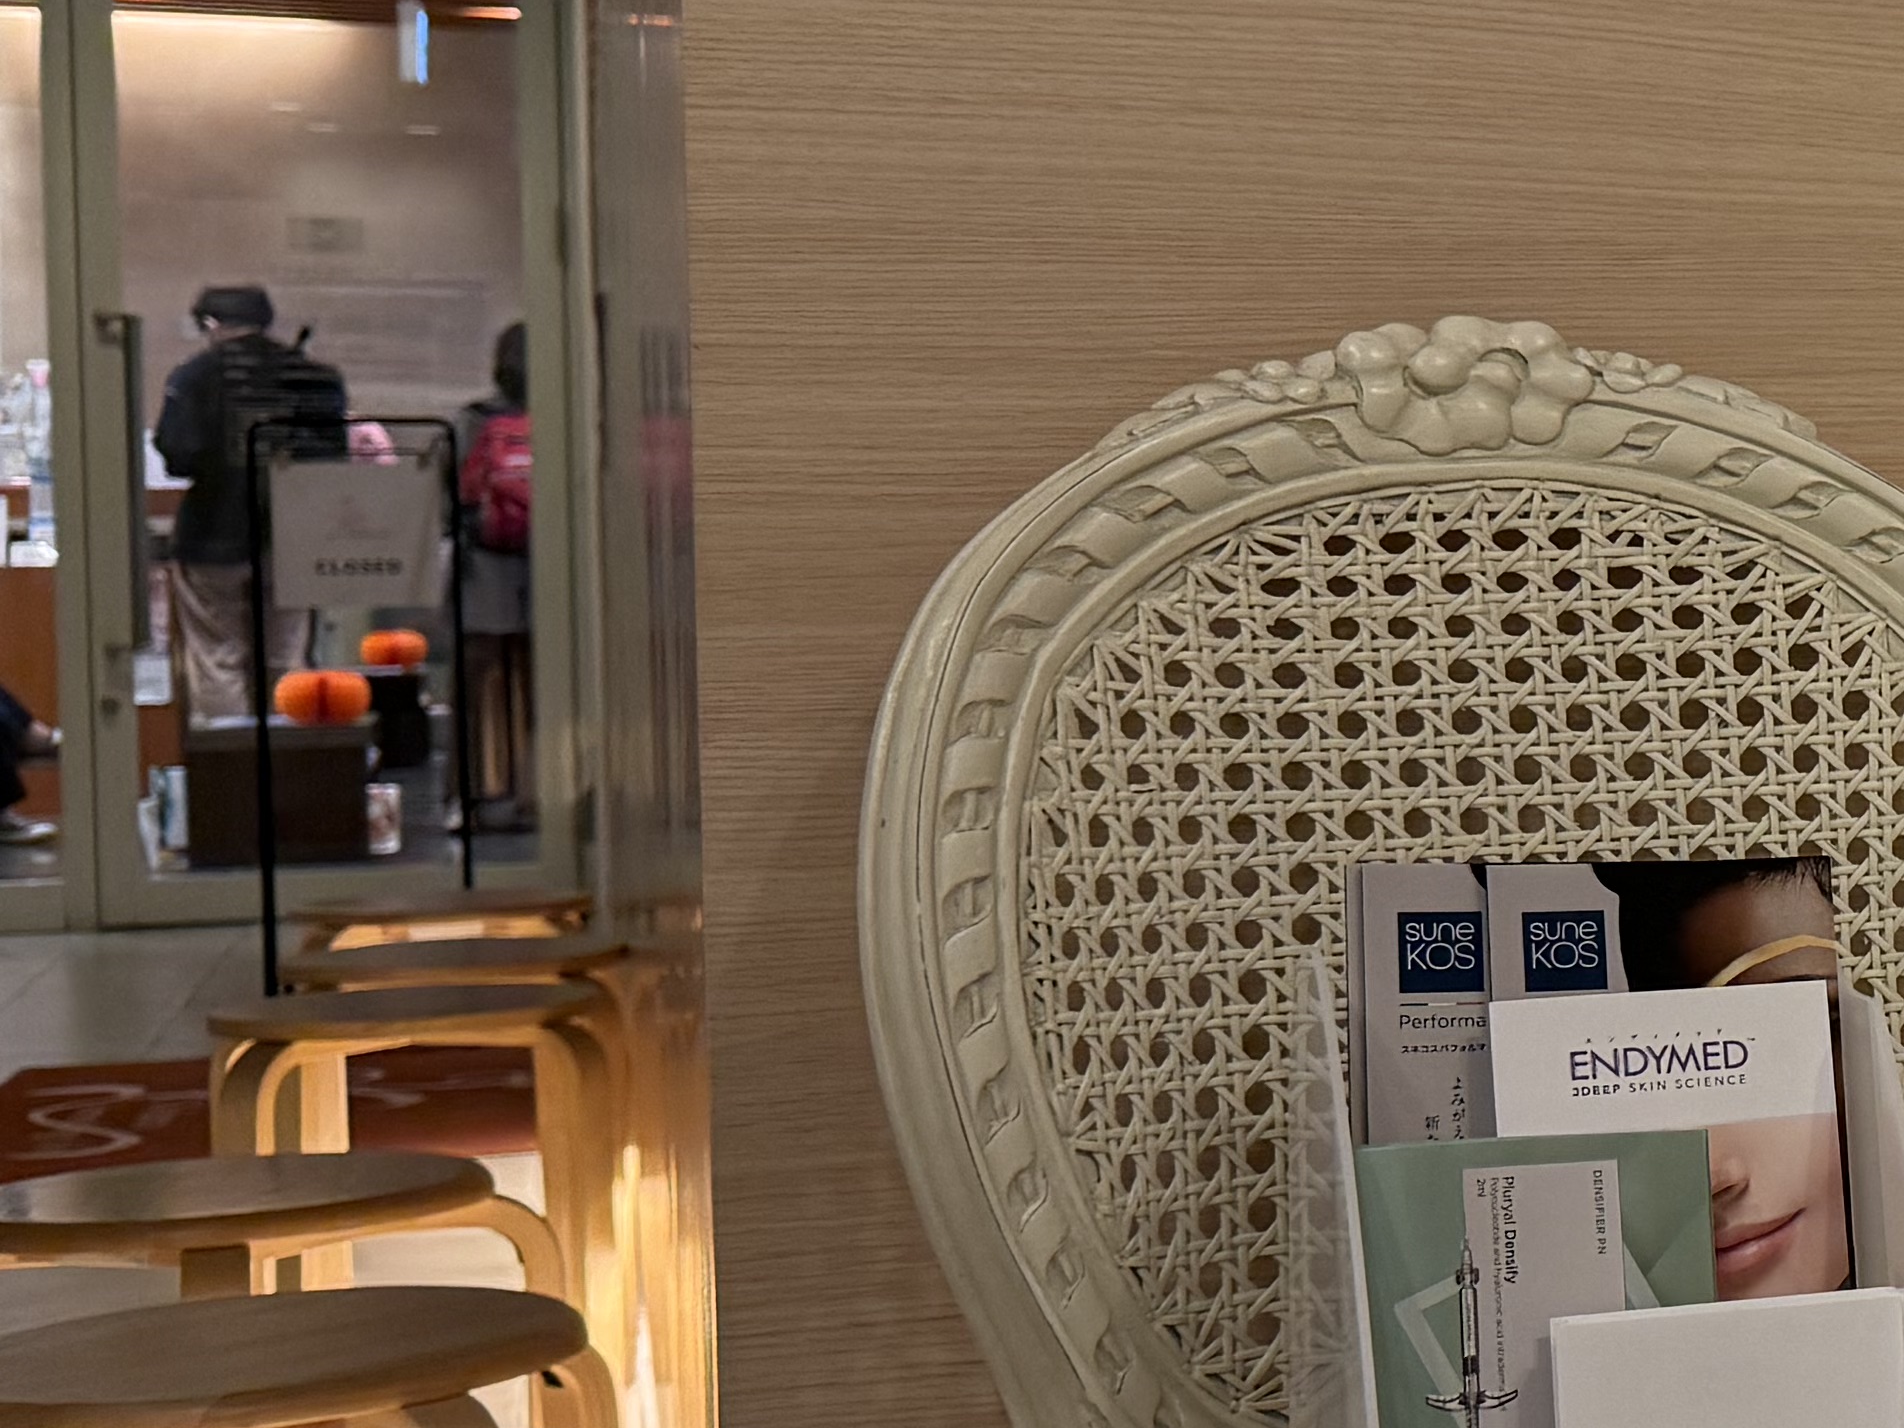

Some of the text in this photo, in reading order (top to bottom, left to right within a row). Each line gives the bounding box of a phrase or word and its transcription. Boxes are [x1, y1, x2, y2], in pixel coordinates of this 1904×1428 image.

[1405, 922, 1475, 941] sune
[1529, 920, 1599, 940] sune
[1406, 942, 1476, 971] KOS
[1531, 940, 1600, 970] KOS
[1569, 1039, 1750, 1082] ENDYMED
[1628, 1079, 1667, 1094] SKIN
[1675, 1073, 1748, 1090] SCIENCE
[1501, 1175, 1517, 1226] Pluryal
[1592, 1169, 1606, 1234] DENSIFIER
